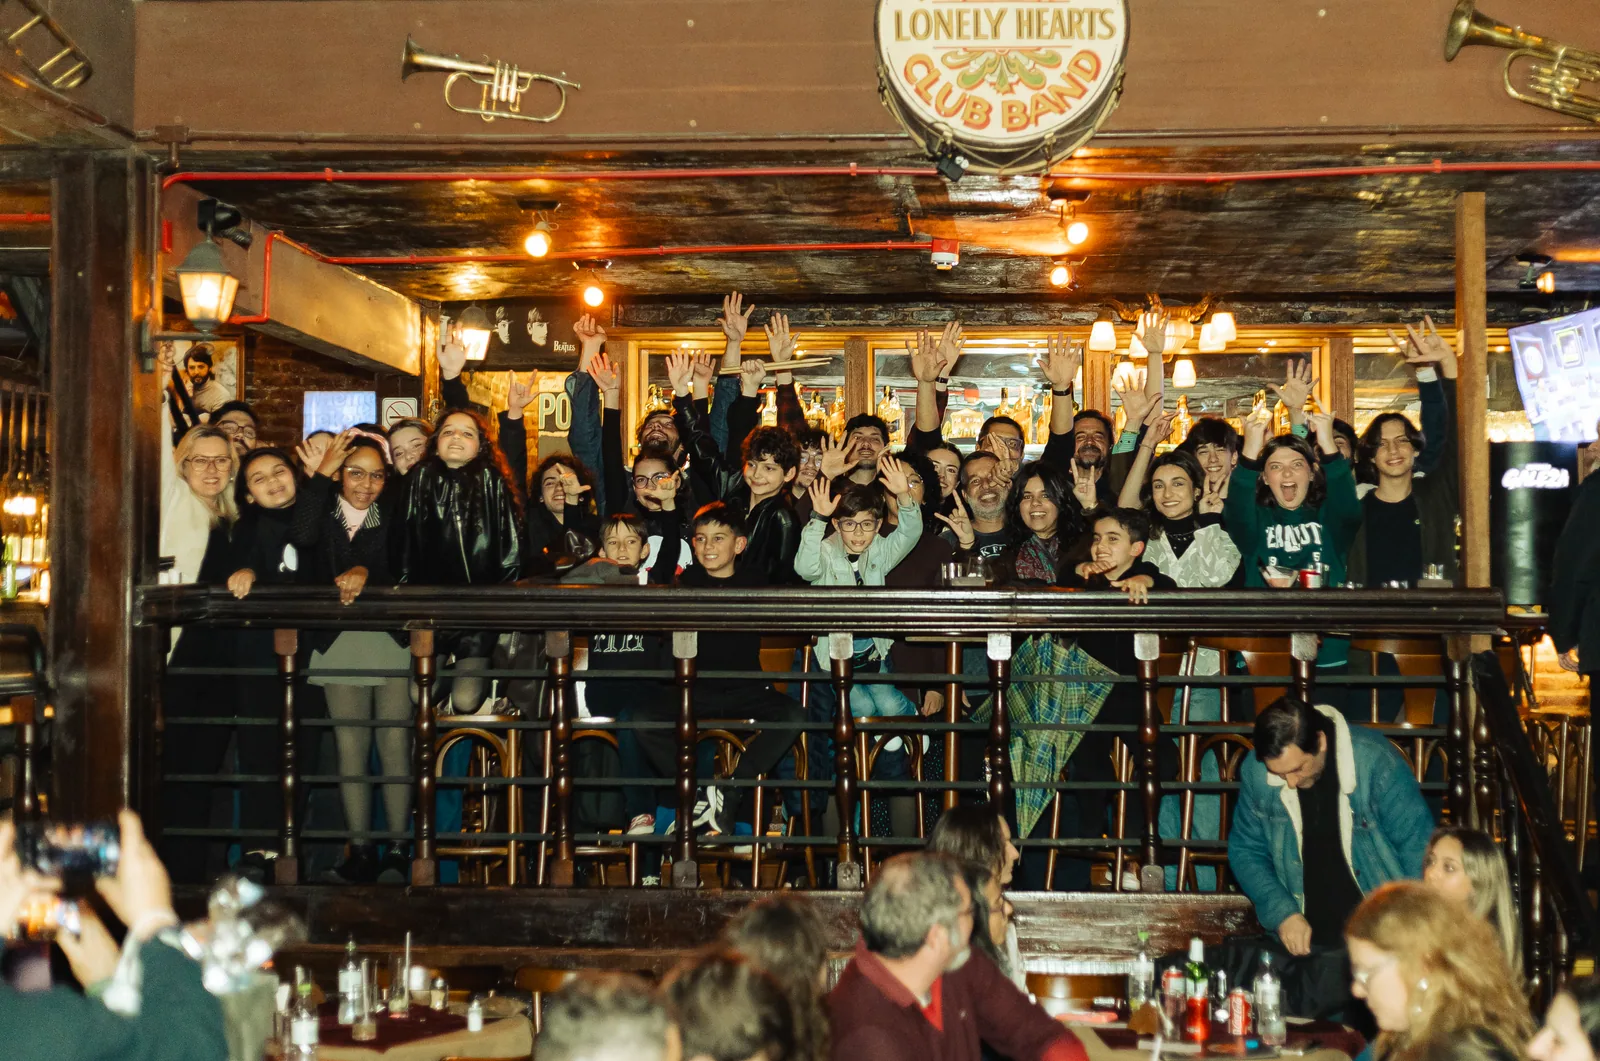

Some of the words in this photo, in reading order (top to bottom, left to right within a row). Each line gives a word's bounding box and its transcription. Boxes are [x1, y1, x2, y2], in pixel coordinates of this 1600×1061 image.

[894, 8, 1008, 41] LONELY
[1016, 8, 1117, 41] HEARTS
[904, 53, 993, 130] CLUB
[1001, 50, 1102, 132] BAND
